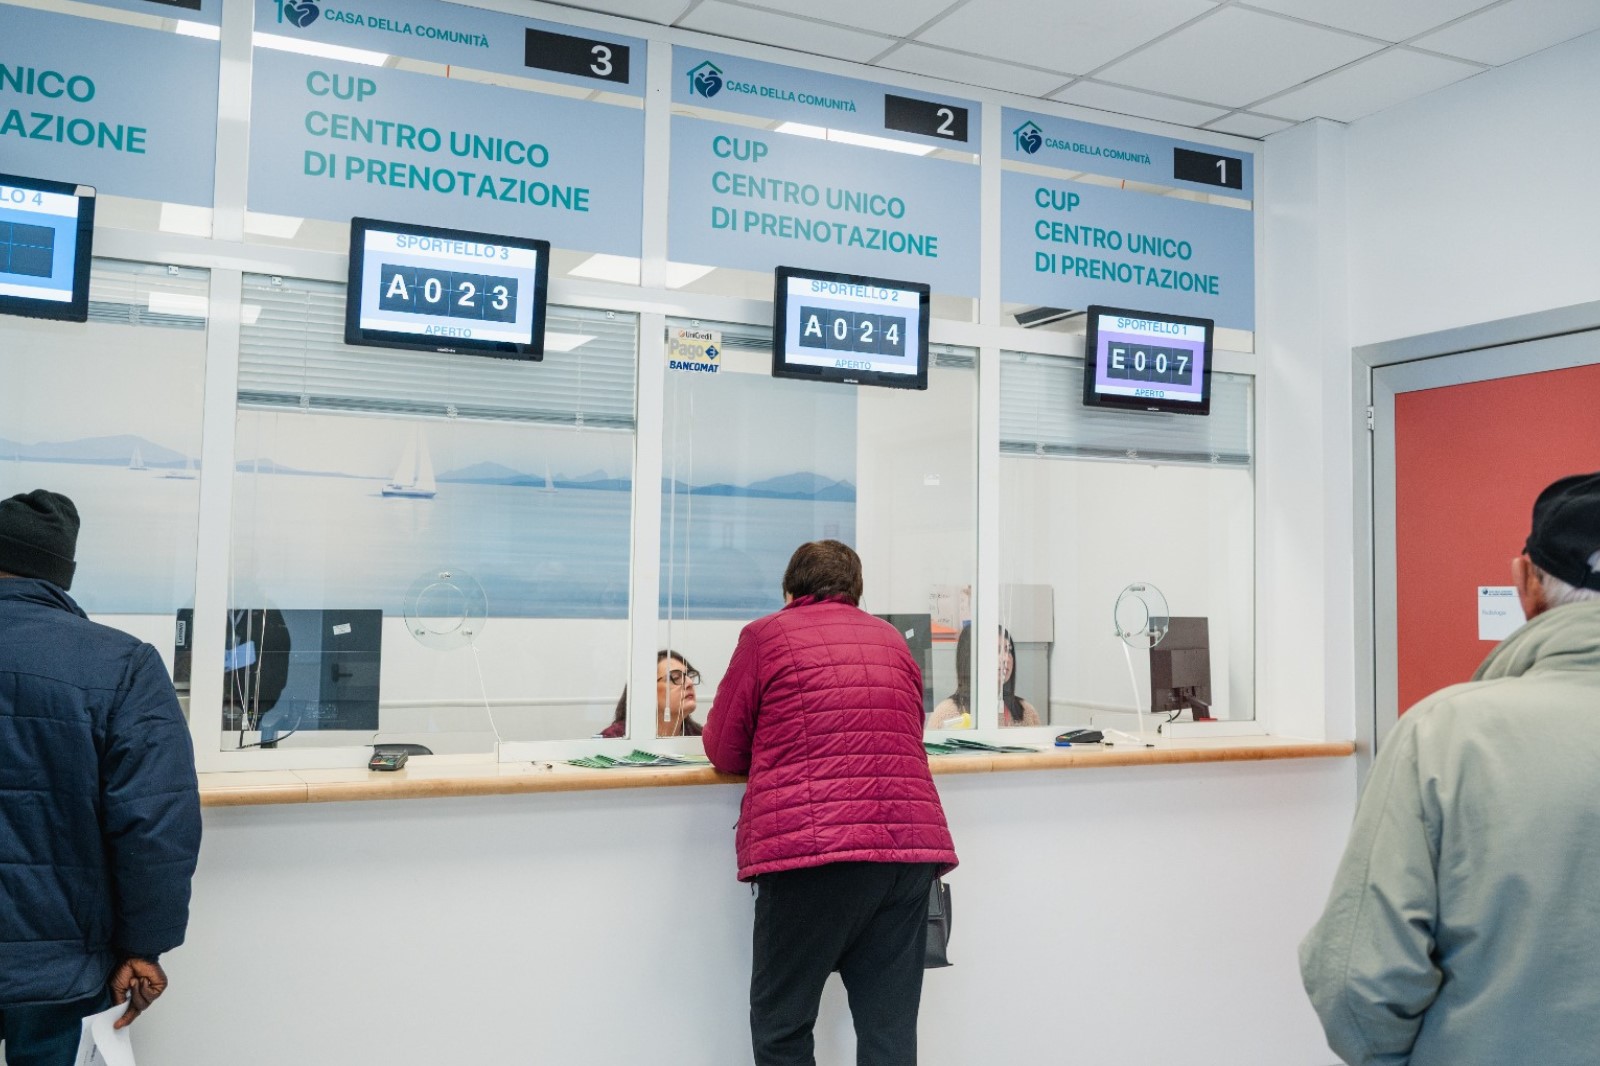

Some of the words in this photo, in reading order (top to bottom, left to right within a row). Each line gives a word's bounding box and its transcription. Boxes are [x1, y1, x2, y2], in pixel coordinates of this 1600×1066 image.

[324, 8, 365, 26] CASA
[367, 16, 412, 35] DELLA
[415, 24, 490, 48] COMUNITÀ
[589, 45, 613, 76] 3
[306, 70, 377, 102] CUP
[726, 80, 758, 95] CASA
[760, 86, 796, 102] DELLA
[798, 93, 857, 113] COMUNITÀ
[936, 108, 955, 136] 2
[304, 110, 441, 153] CENTRO
[449, 131, 549, 168] UNICO
[712, 135, 769, 163] CUP
[1045, 138, 1071, 151] CASA
[1073, 143, 1101, 157] DELLA
[1102, 149, 1151, 165] COMUNITÀ
[304, 150, 336, 178] DI
[345, 155, 590, 212] PRENOTAZIONE
[1216, 160, 1226, 183] 1
[31, 192, 43, 206] 4
[711, 171, 820, 207] CENTRO
[826, 188, 906, 219] UNICO
[1034, 187, 1080, 212] CUP
[711, 206, 737, 231] DI
[744, 211, 938, 258] PRENOTAZIONE
[1034, 220, 1123, 251] CENTRO
[1127, 233, 1192, 260] UNICO
[396, 234, 496, 259] SPORTELLO
[499, 247, 510, 260] 3
[1035, 252, 1056, 273] DI
[1062, 255, 1219, 295] PRENOTAZIONE
[386, 273, 509, 310] A023
[811, 280, 888, 300] SPORTELLO
[891, 291, 899, 302] 2
[425, 324, 472, 338] APERTO
[804, 314, 900, 345] A024
[1117, 318, 1179, 335] SPORTELLO
[1182, 325, 1187, 335] 1
[670, 361, 719, 373] BANCOMAT
[834, 358, 872, 370] APERTO
[1112, 348, 1188, 374] E007
[1134, 389, 1165, 398] APERTO
